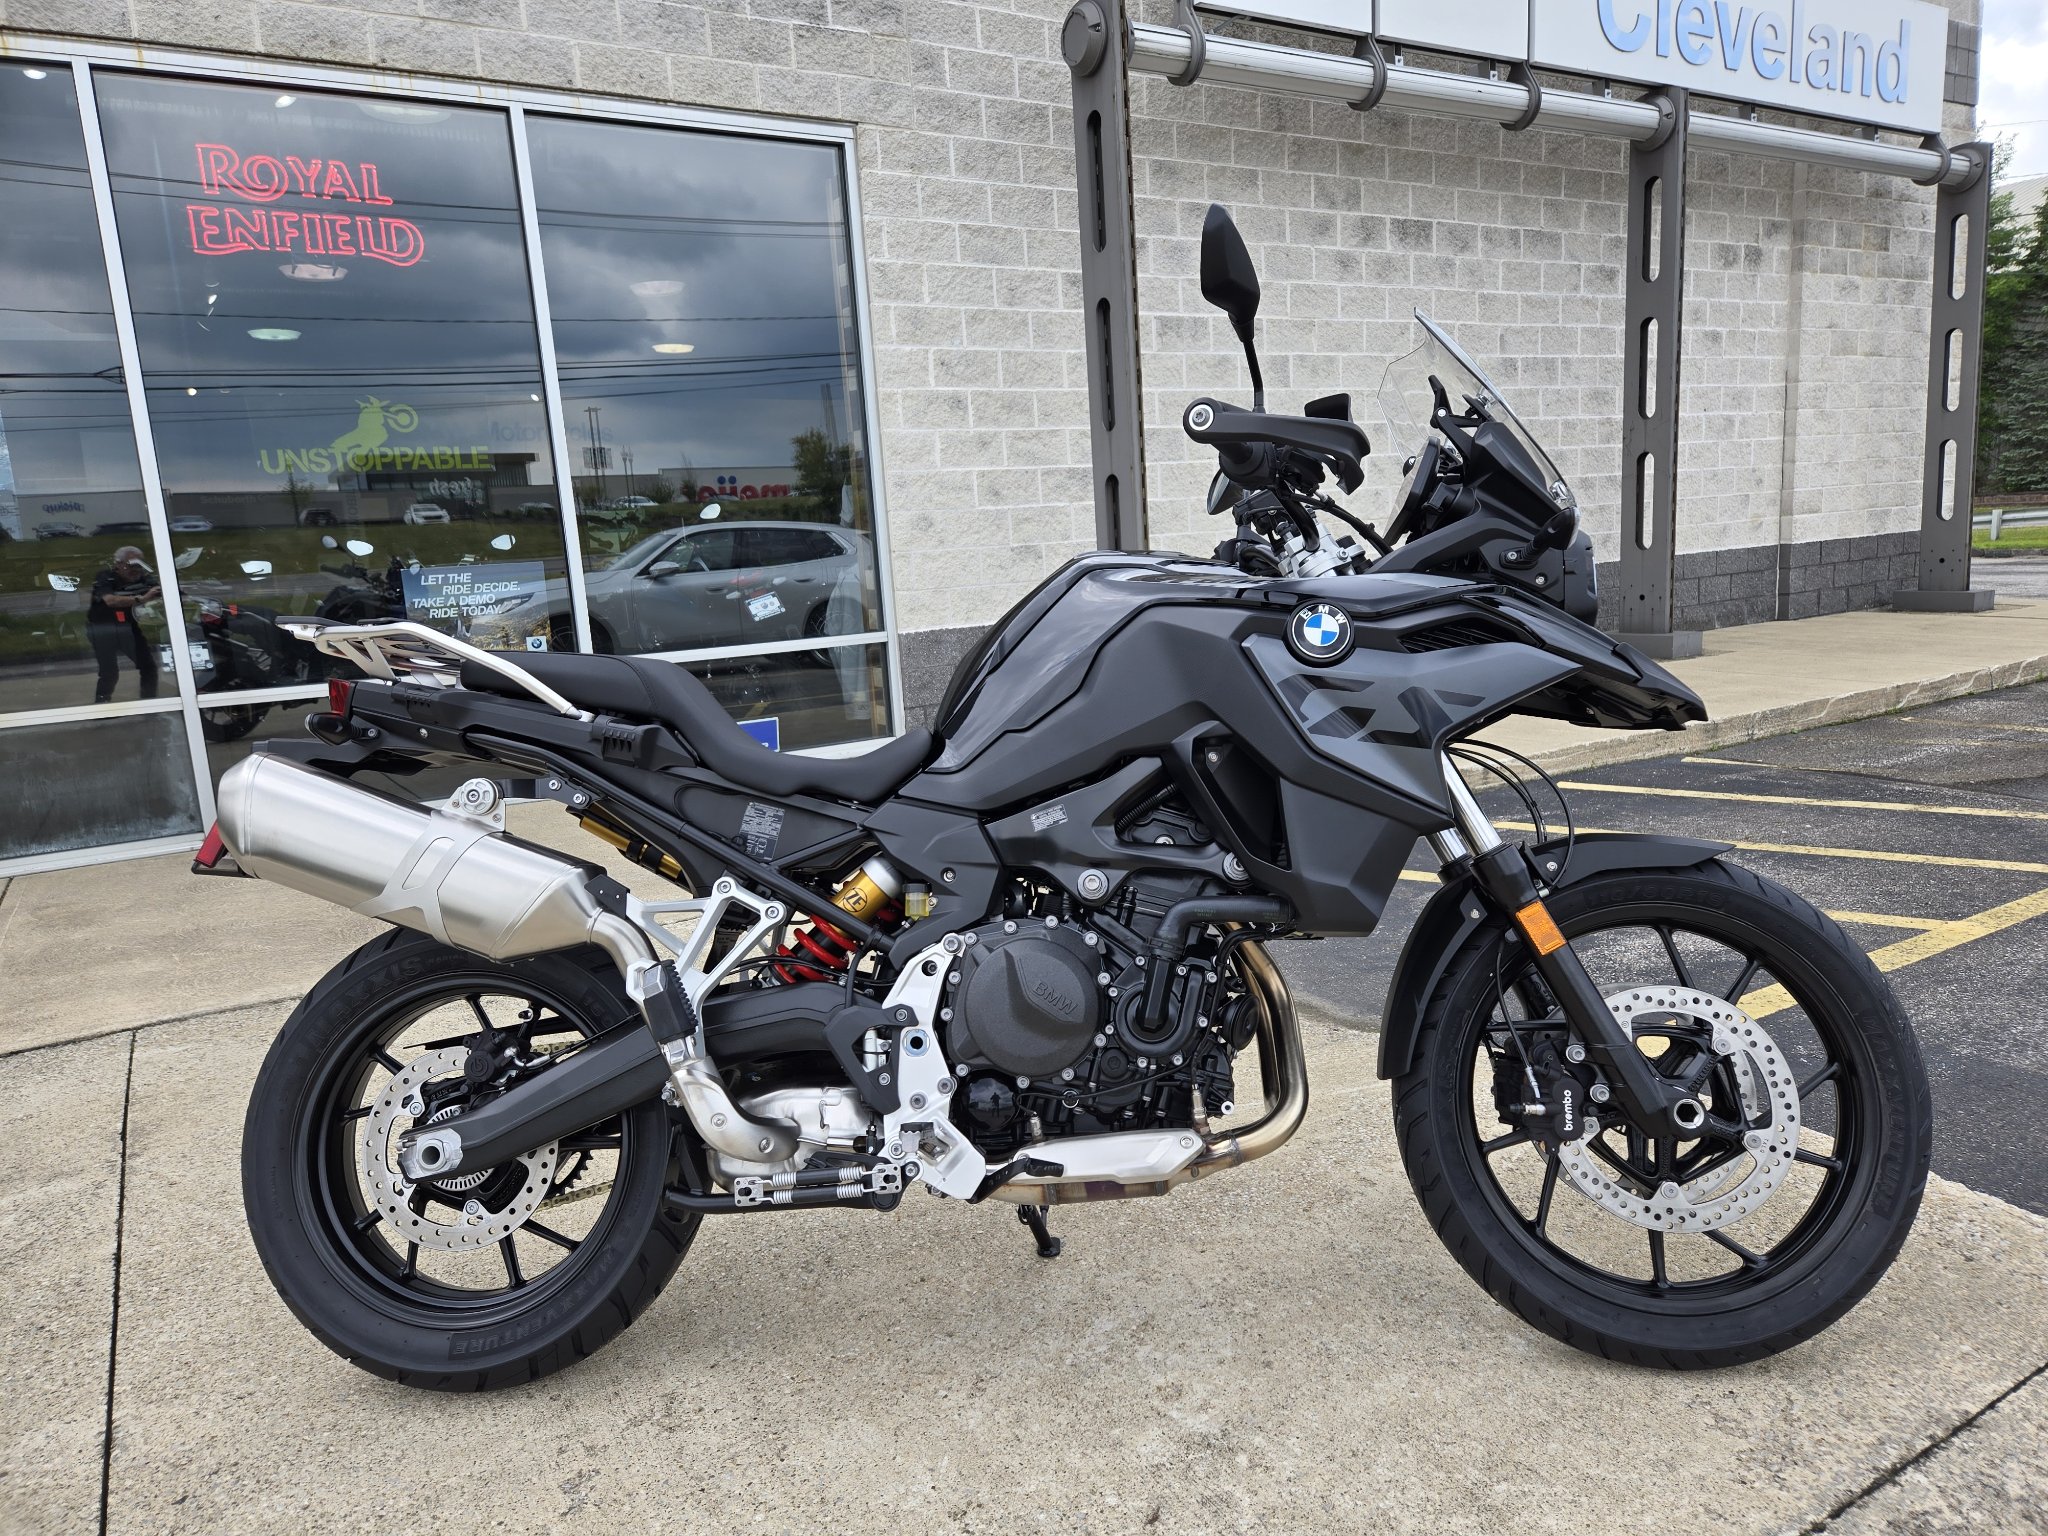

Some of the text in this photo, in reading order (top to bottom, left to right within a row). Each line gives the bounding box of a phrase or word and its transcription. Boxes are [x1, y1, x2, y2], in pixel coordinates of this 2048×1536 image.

[1597, 0, 1911, 104] Cleveland
[195, 143, 394, 206] ROYAL
[186, 205, 424, 267] ENFIELD
[260, 445, 491, 475] UNSTOPPABLE
[421, 572, 472, 586] LET THE
[442, 581, 521, 596] RIDE DECIDE.
[412, 594, 496, 609] TAKE A DEMO
[429, 604, 502, 619] RIDE TODAY.
[1299, 604, 1347, 624] BMW
[1032, 981, 1079, 1015] BMW
[1561, 1089, 1574, 1132] brembo
